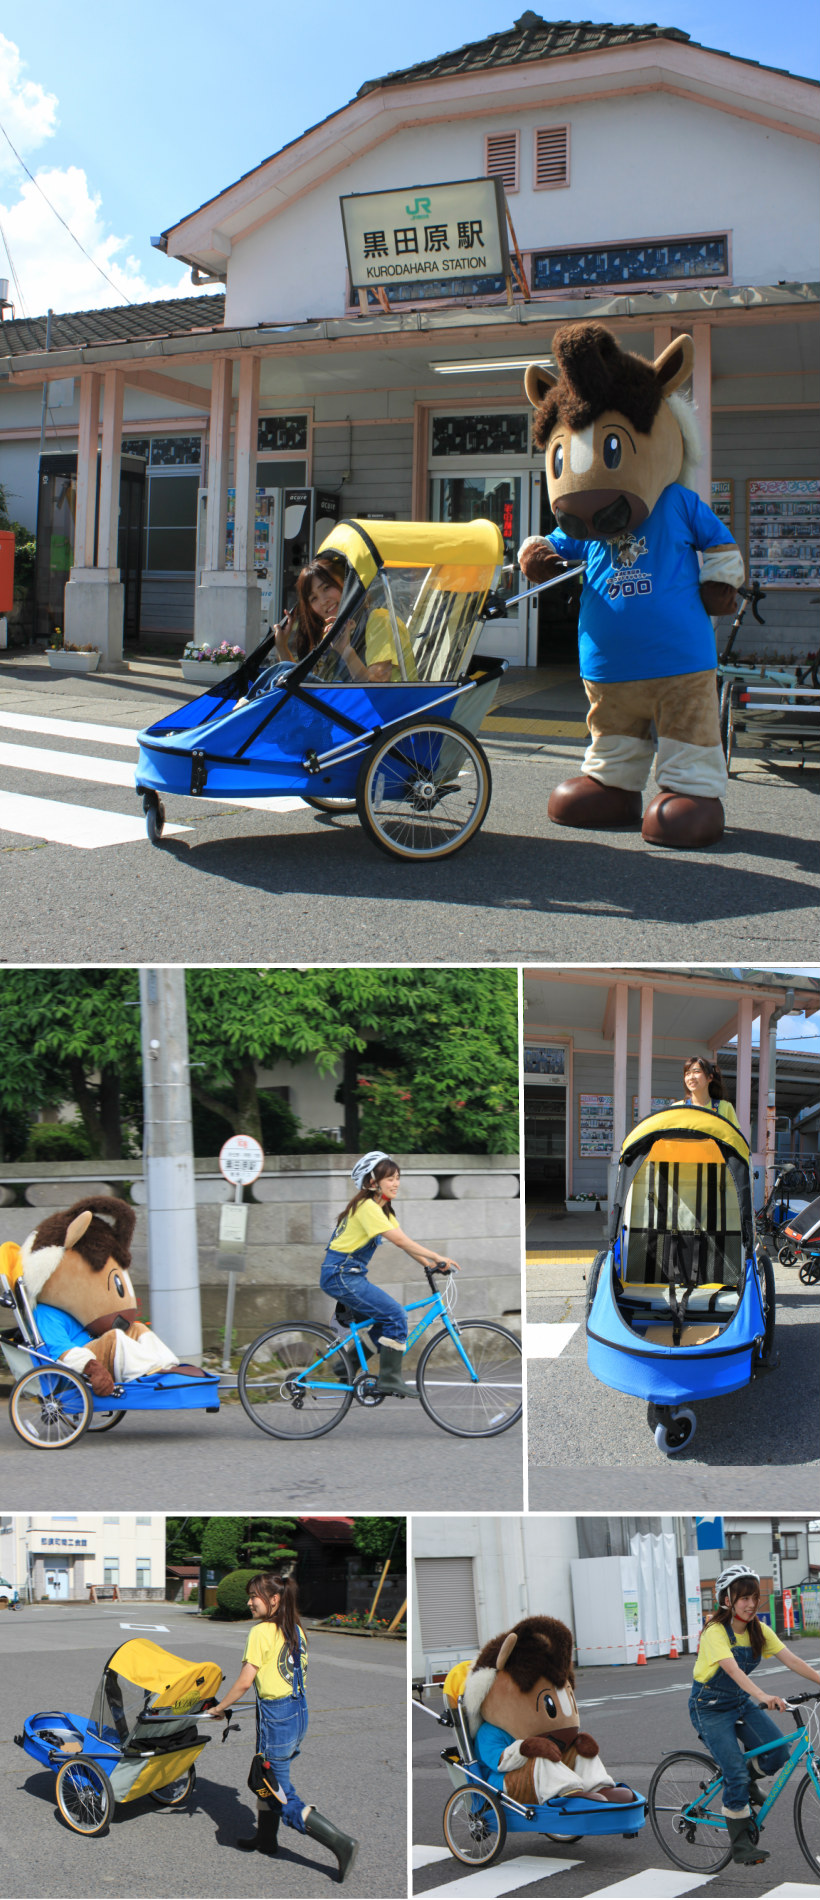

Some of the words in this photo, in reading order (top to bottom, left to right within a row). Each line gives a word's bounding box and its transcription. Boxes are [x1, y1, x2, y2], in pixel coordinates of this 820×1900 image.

[405, 197, 432, 214] JR
[363, 220, 485, 259] 黒田原駅
[366, 263, 439, 278] KURODAHARA
[442, 256, 487, 271] STATION
